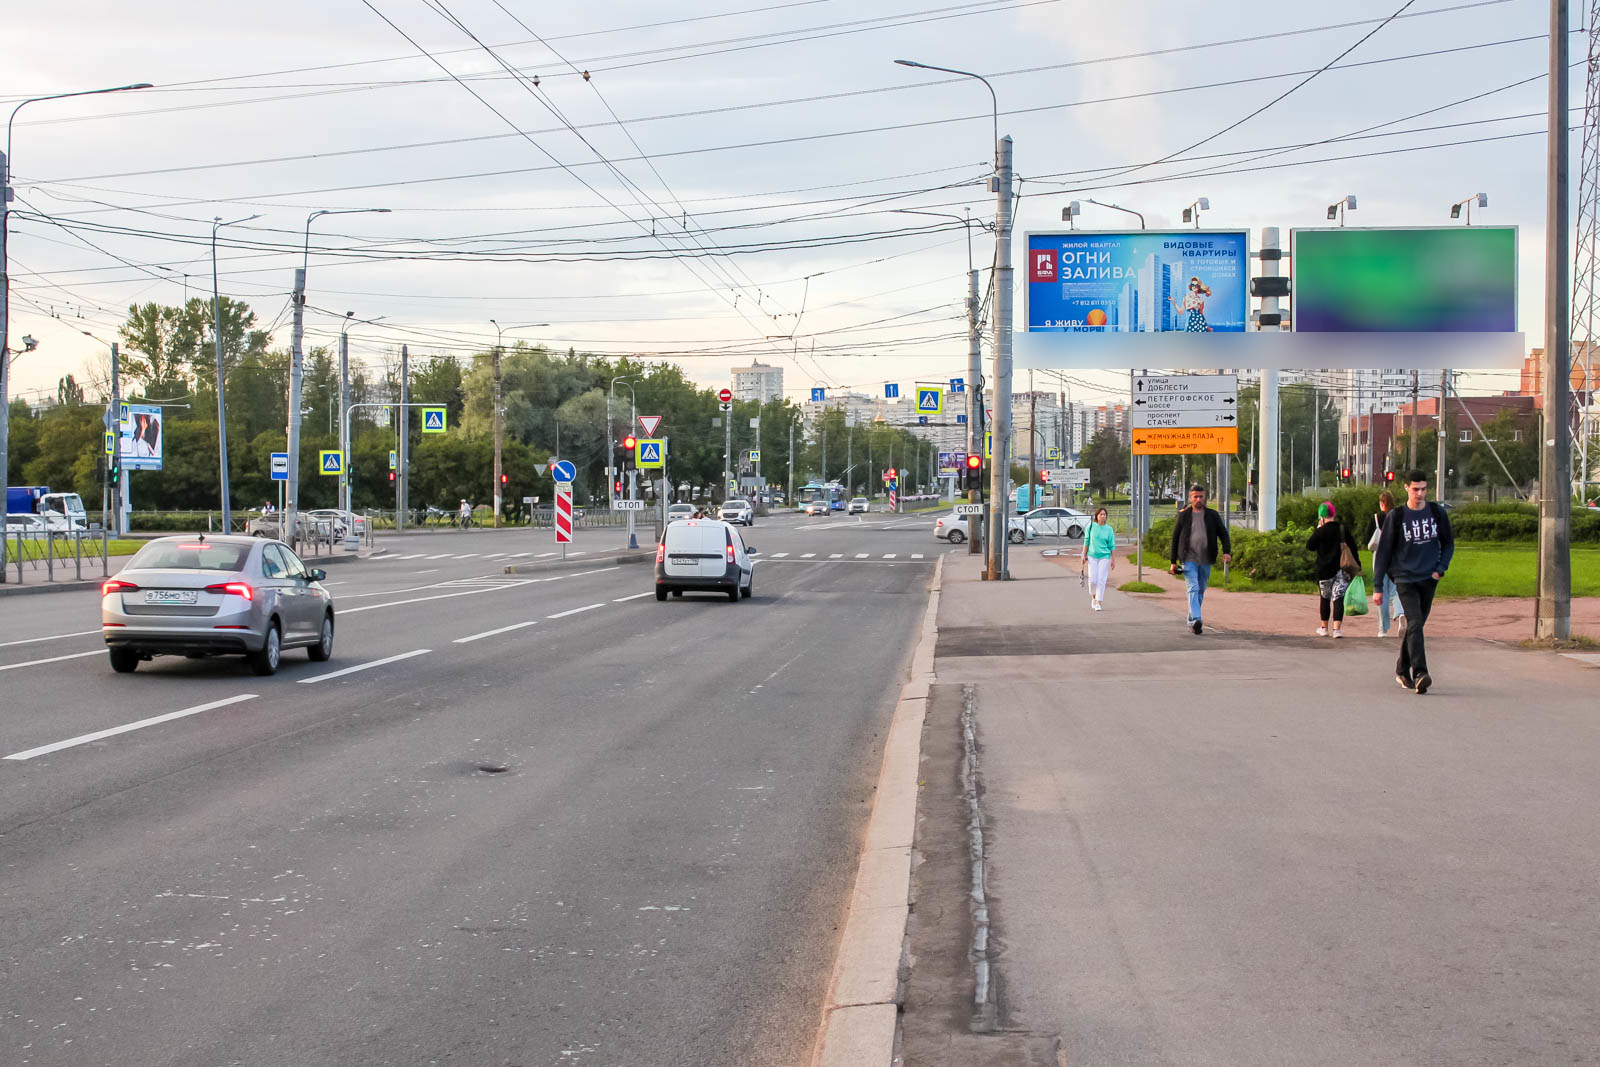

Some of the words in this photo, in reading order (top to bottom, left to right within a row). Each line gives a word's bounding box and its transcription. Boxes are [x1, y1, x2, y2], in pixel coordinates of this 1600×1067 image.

[1163, 241, 1214, 250] ВИДОВЫЕ
[1182, 249, 1237, 257] КВАРТИРЫ
[1062, 251, 1111, 264] ОГНИ
[1062, 266, 1137, 280] ЗАЛИВА
[1044, 319, 1051, 327] Я
[1055, 319, 1084, 327] ЖИВУ
[1147, 384, 1189, 392] ДОБЛЕСТИ
[1147, 394, 1215, 402] ПЕТЕРГОФСКОЕ
[1147, 432, 1191, 440] ЖЕМЧУЖНАЯ
[1178, 442, 1198, 450] центр
[617, 501, 640, 509] СТОП
[957, 505, 980, 514] СТОП
